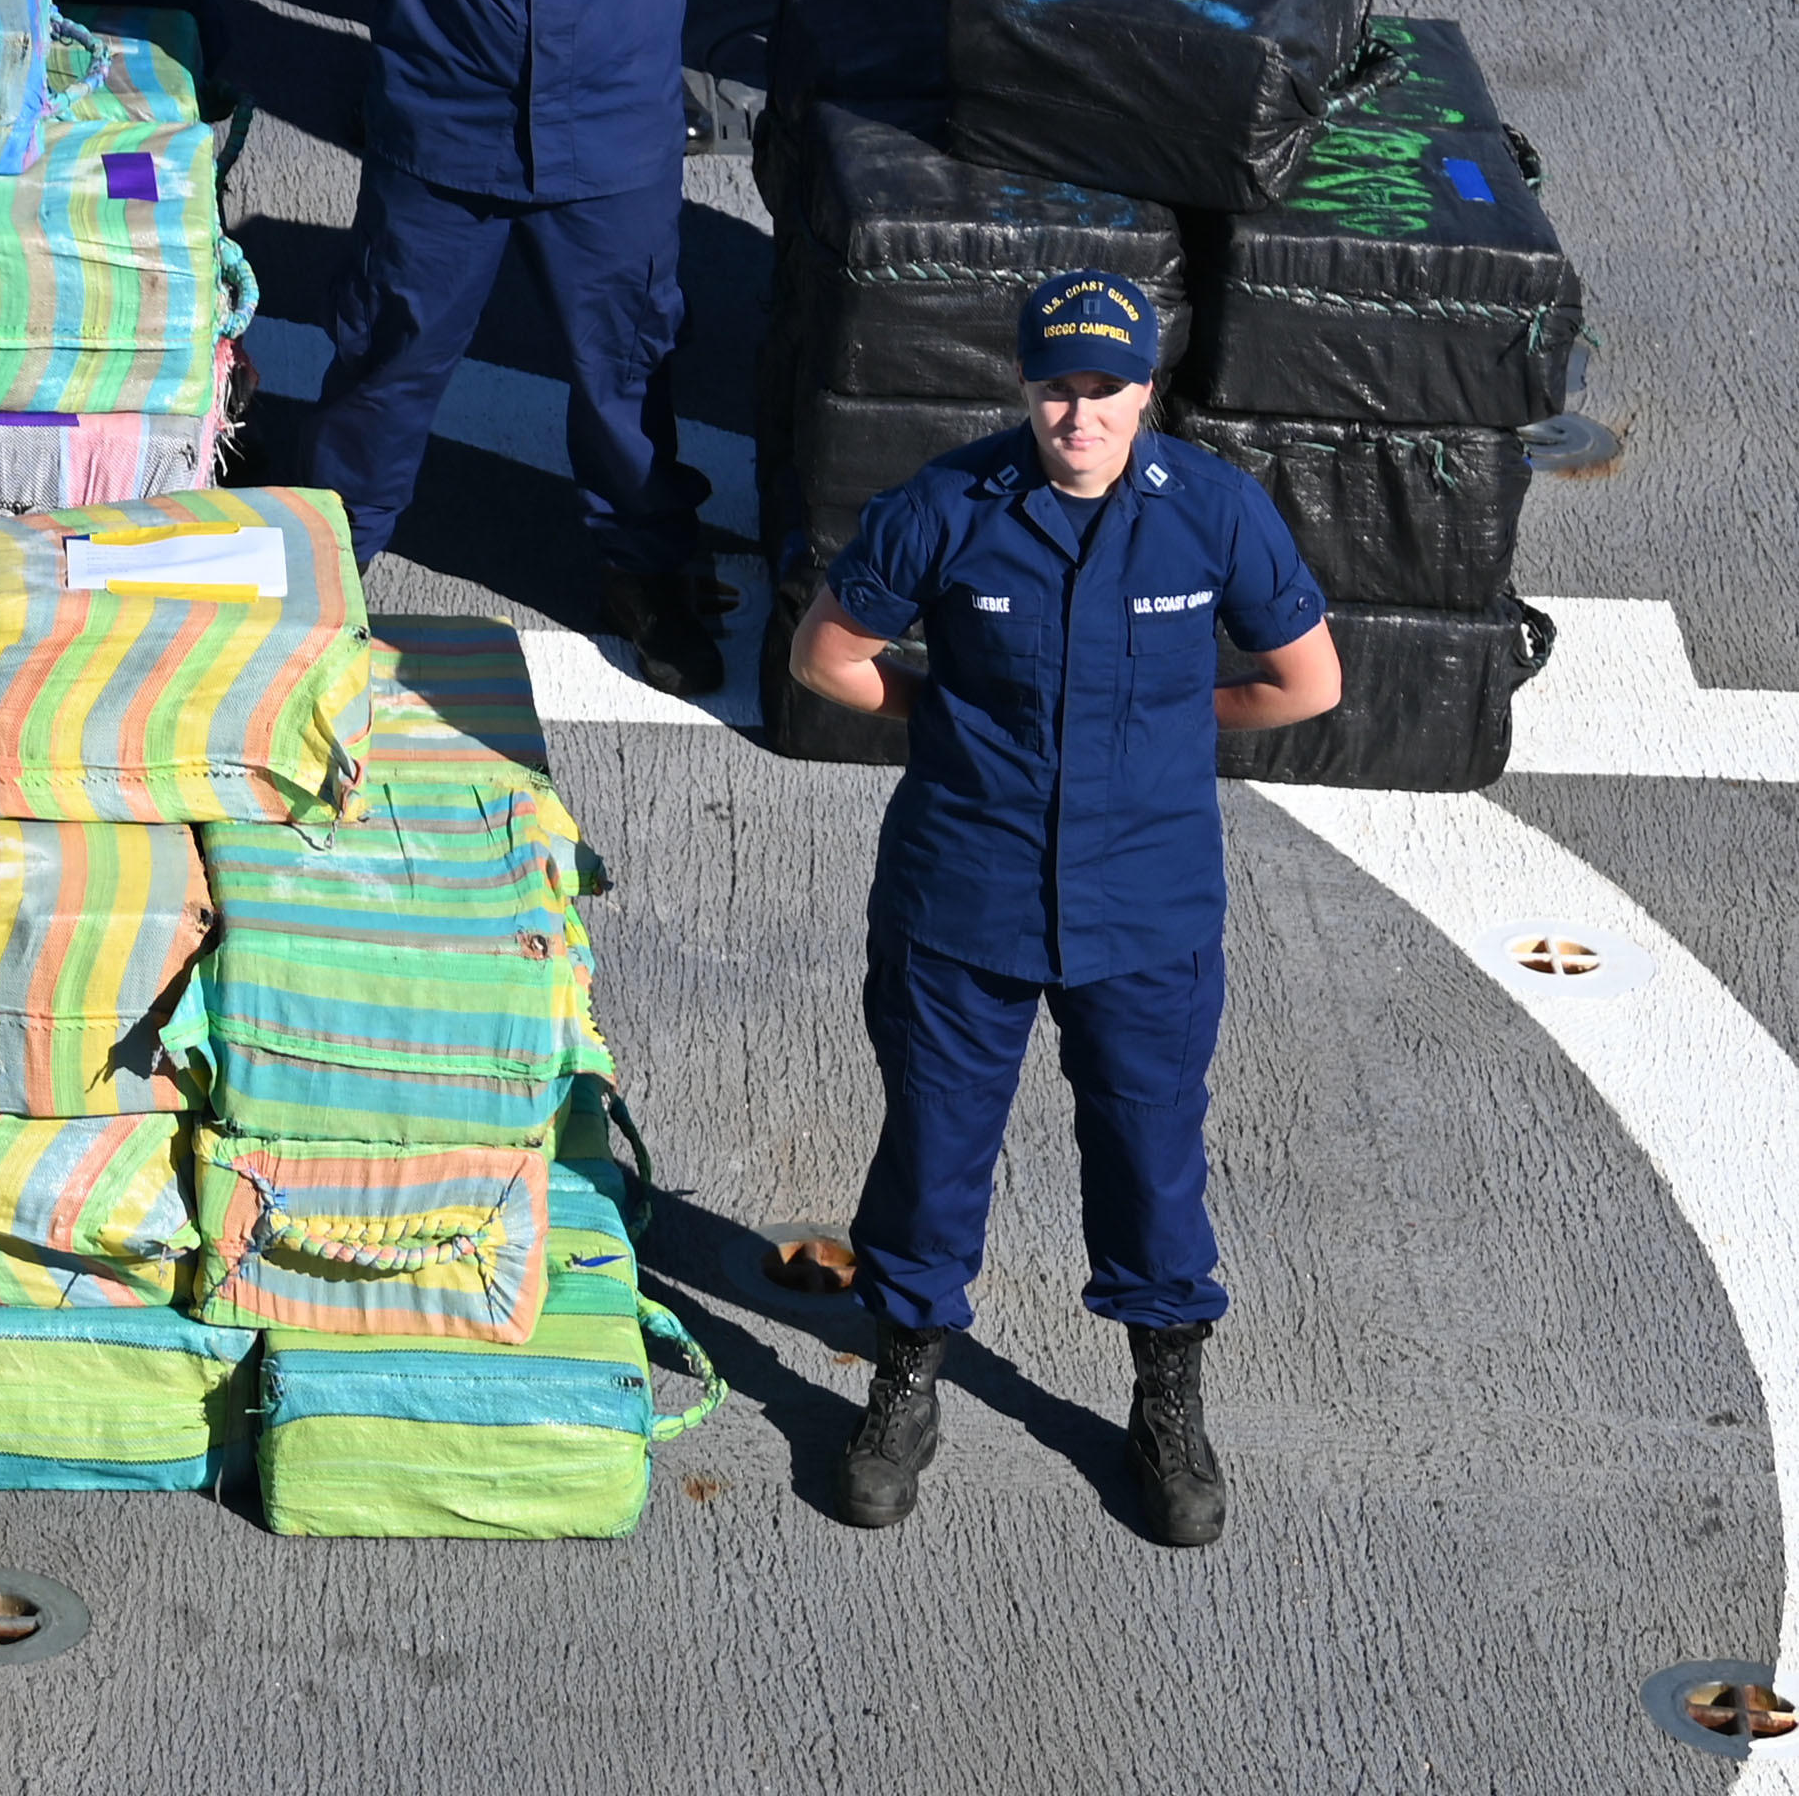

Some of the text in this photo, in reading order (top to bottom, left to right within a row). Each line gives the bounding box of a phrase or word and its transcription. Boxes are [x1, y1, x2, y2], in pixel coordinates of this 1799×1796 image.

[1041, 280, 1142, 322] U.S. COAST GUARD
[1043, 322, 1132, 345] USCGC CAMPBELL
[972, 595, 1010, 613] LUEBKE
[1133, 590, 1214, 614] U.S. COAST GUARD
